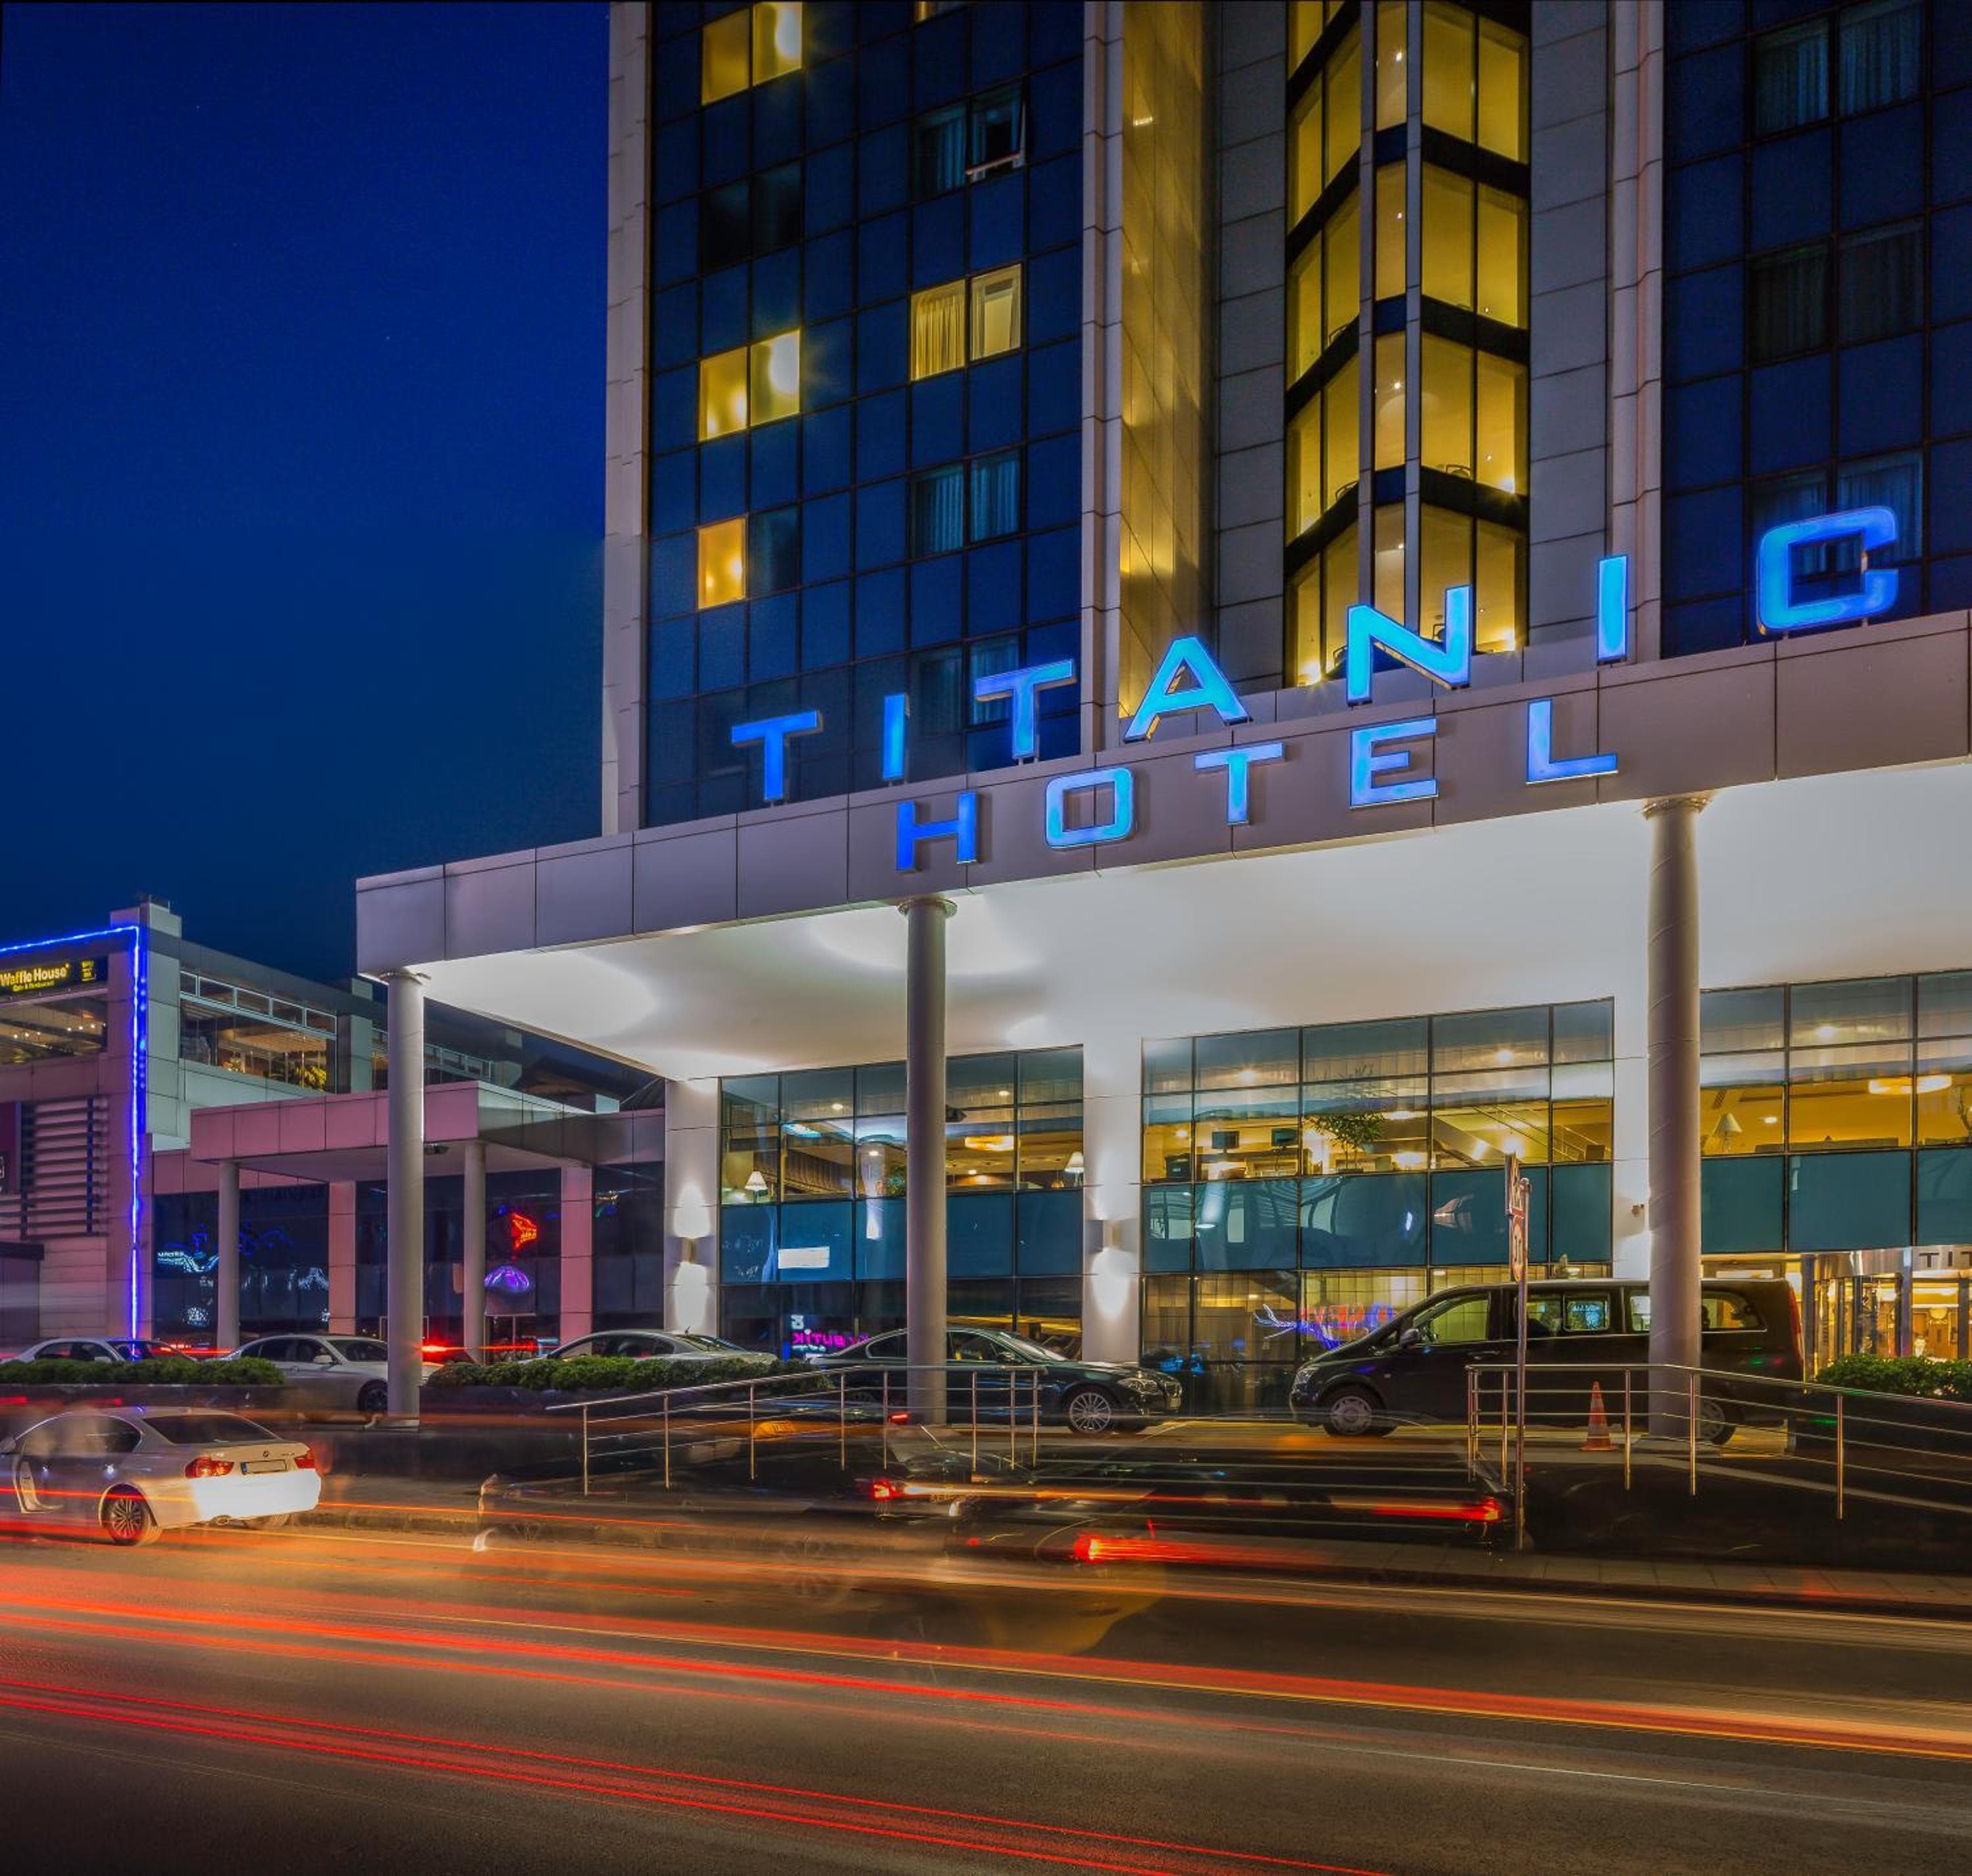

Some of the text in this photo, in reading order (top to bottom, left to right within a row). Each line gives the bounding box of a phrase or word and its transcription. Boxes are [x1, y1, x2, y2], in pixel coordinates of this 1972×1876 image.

[731, 505, 1897, 801] TITANIC
[896, 699, 1618, 871] HOTEL
[0, 970, 32, 986] Waffle
[34, 967, 66, 981] House
